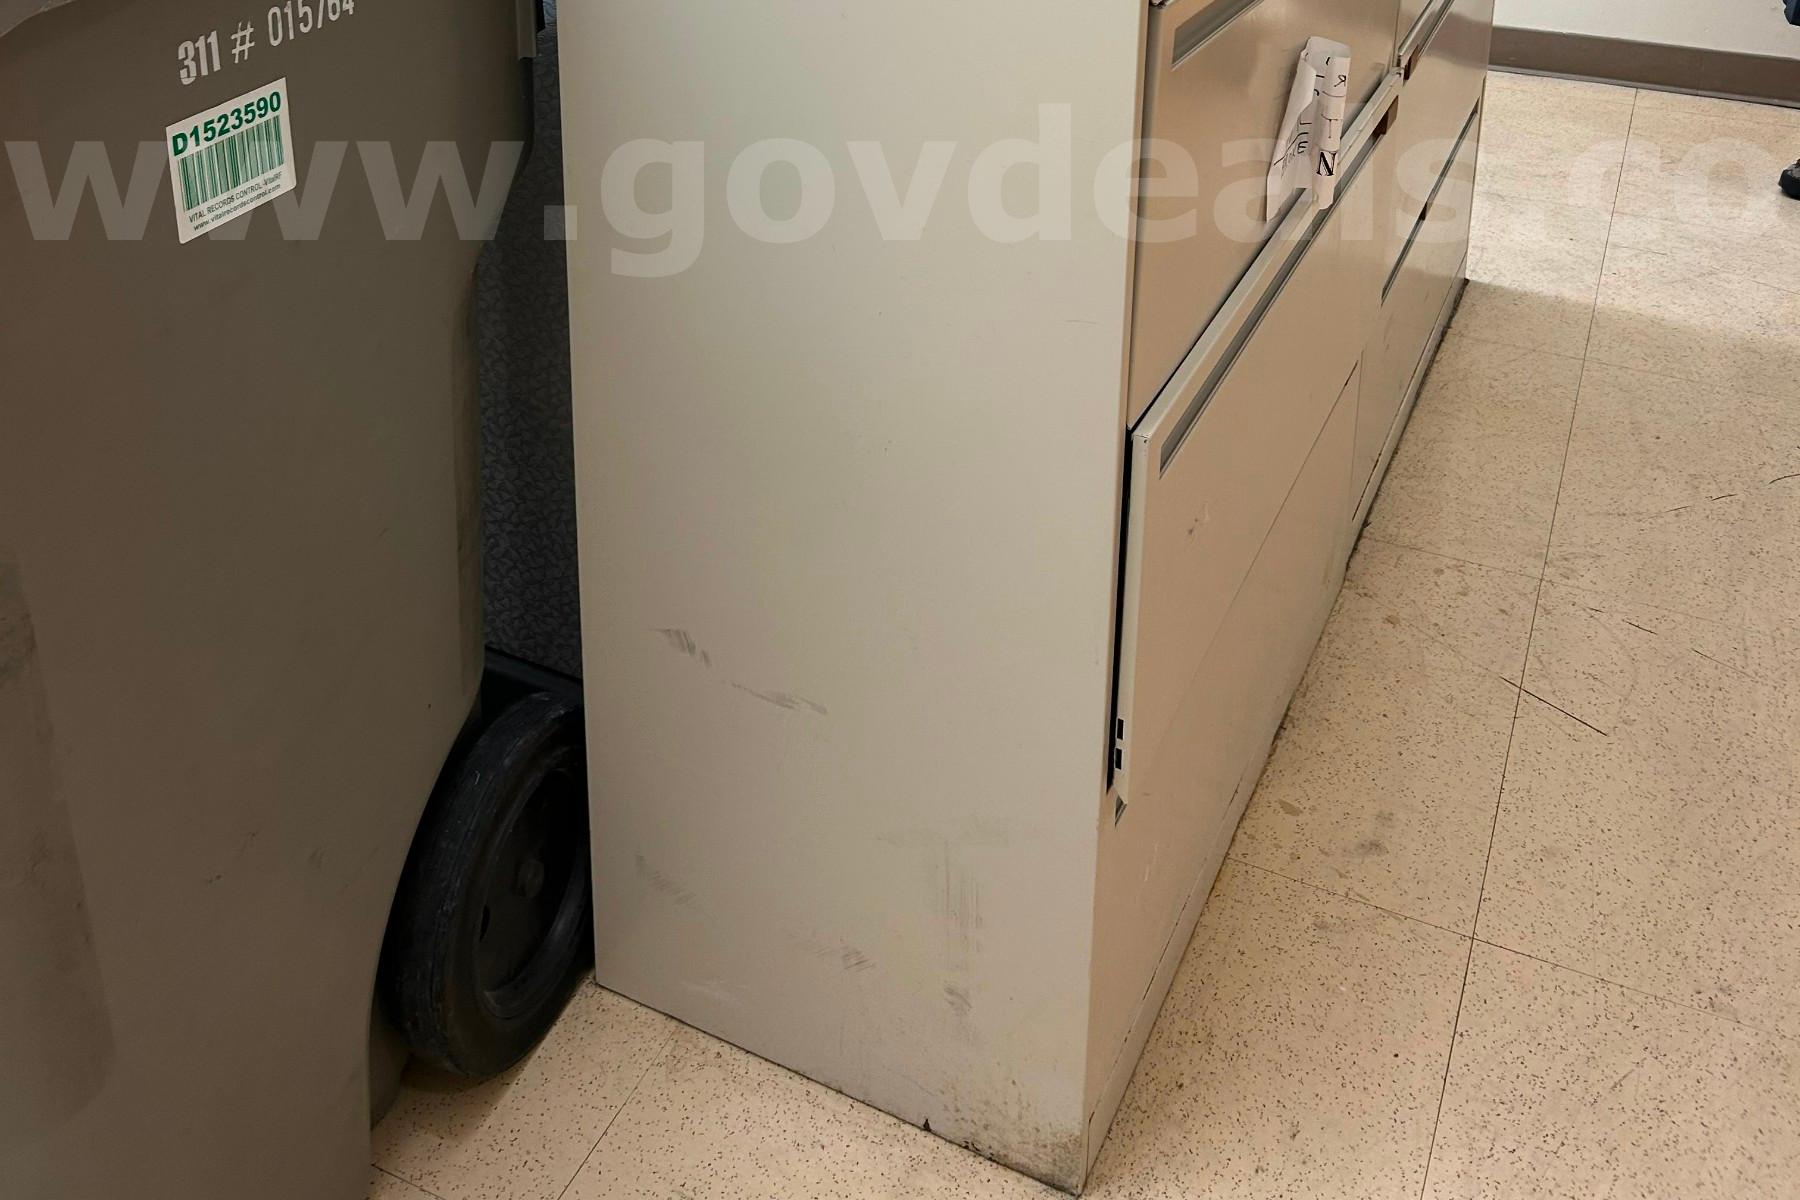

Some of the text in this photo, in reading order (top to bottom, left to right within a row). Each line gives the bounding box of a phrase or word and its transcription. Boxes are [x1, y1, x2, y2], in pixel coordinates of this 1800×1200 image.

[177, 30, 221, 85] 311
[230, 21, 255, 64] #
[172, 91, 282, 156] D1523590
[189, 211, 205, 223] VITAL
[206, 194, 235, 214] RECORDS
[235, 183, 262, 200] CONTROL
[193, 183, 281, 231] www.vitalrecordscontrol.com
